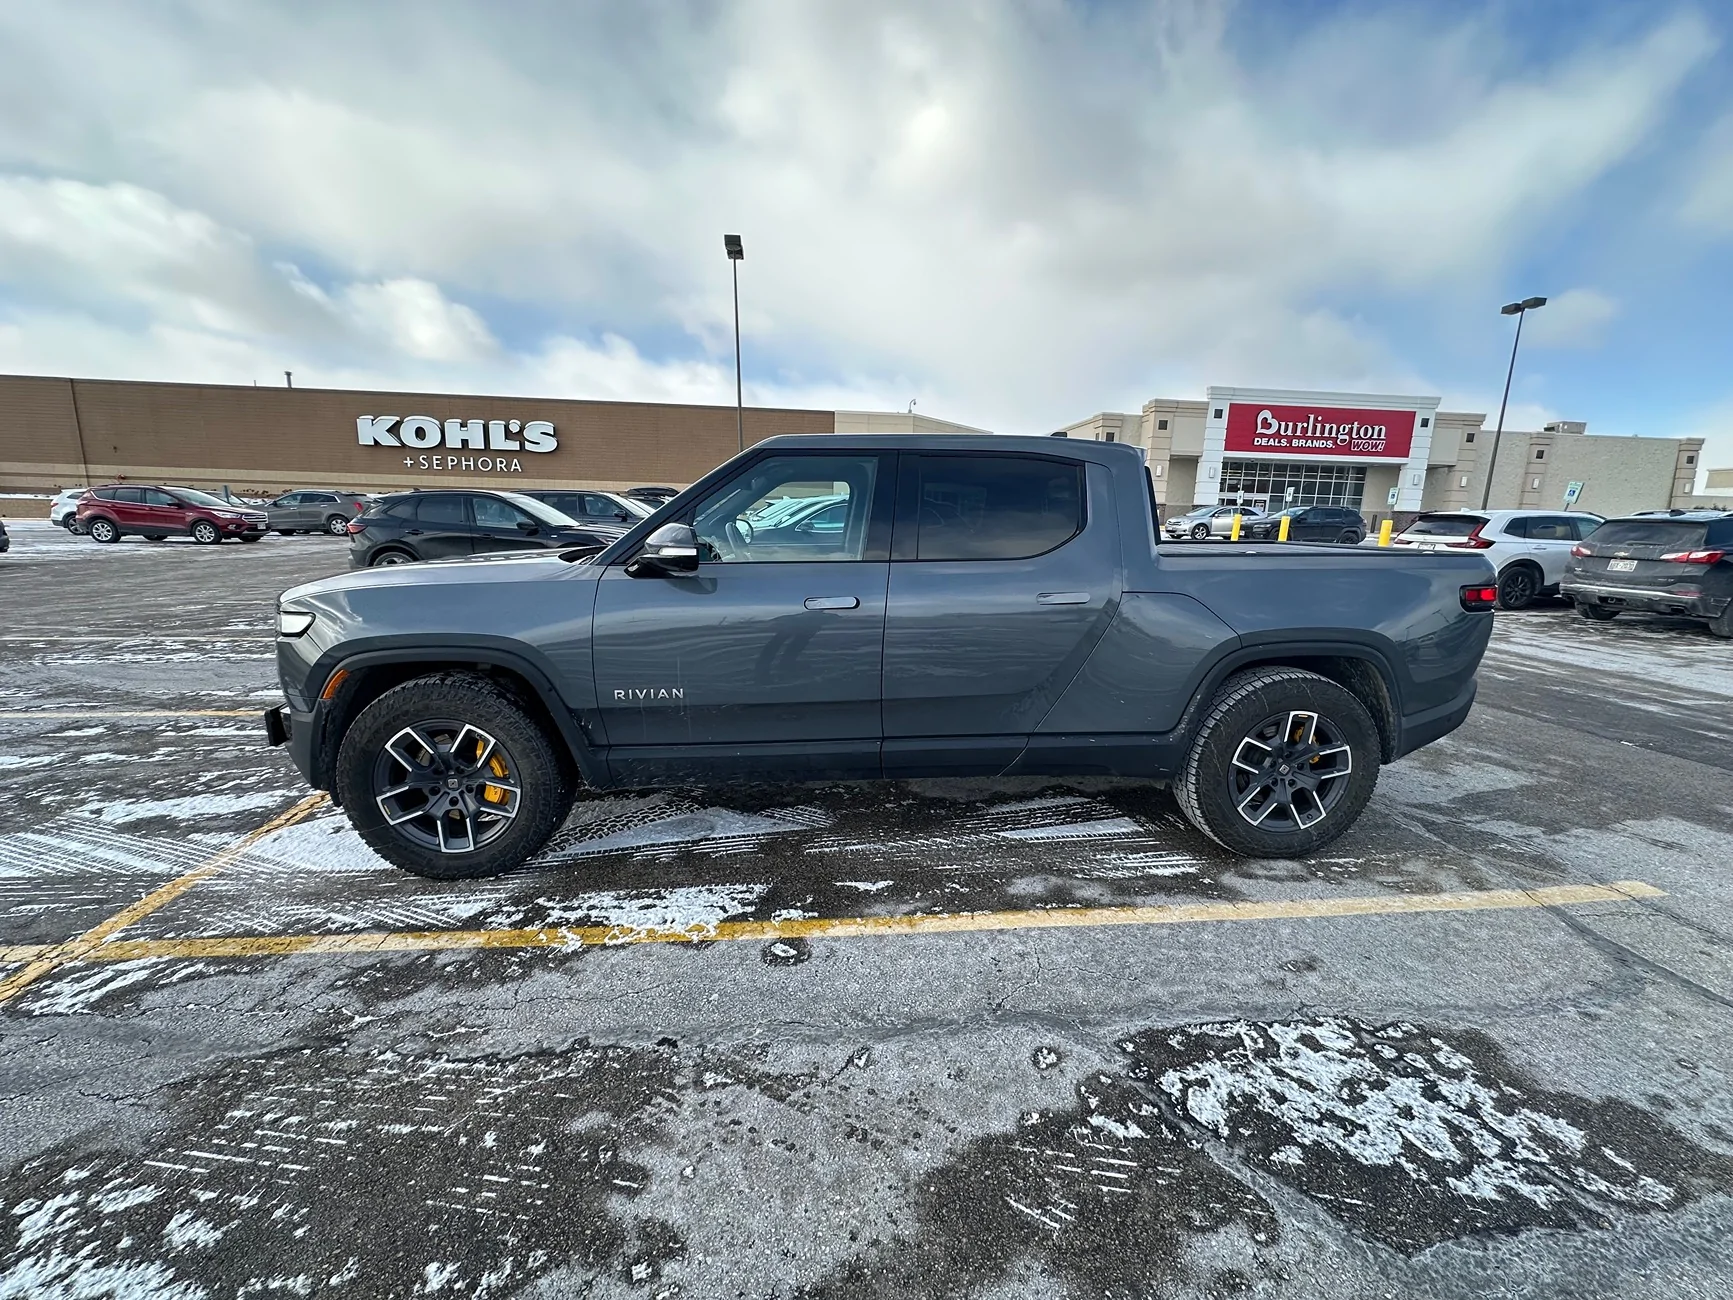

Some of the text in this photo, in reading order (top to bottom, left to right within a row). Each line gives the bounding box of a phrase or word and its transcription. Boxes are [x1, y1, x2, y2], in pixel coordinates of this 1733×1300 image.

[356, 415, 558, 453] KOHL'S
[1256, 409, 1386, 445] Burlington
[1254, 437, 1385, 451] DEALS. BRANDS. WOW!
[614, 688, 684, 700] RIVIAN
